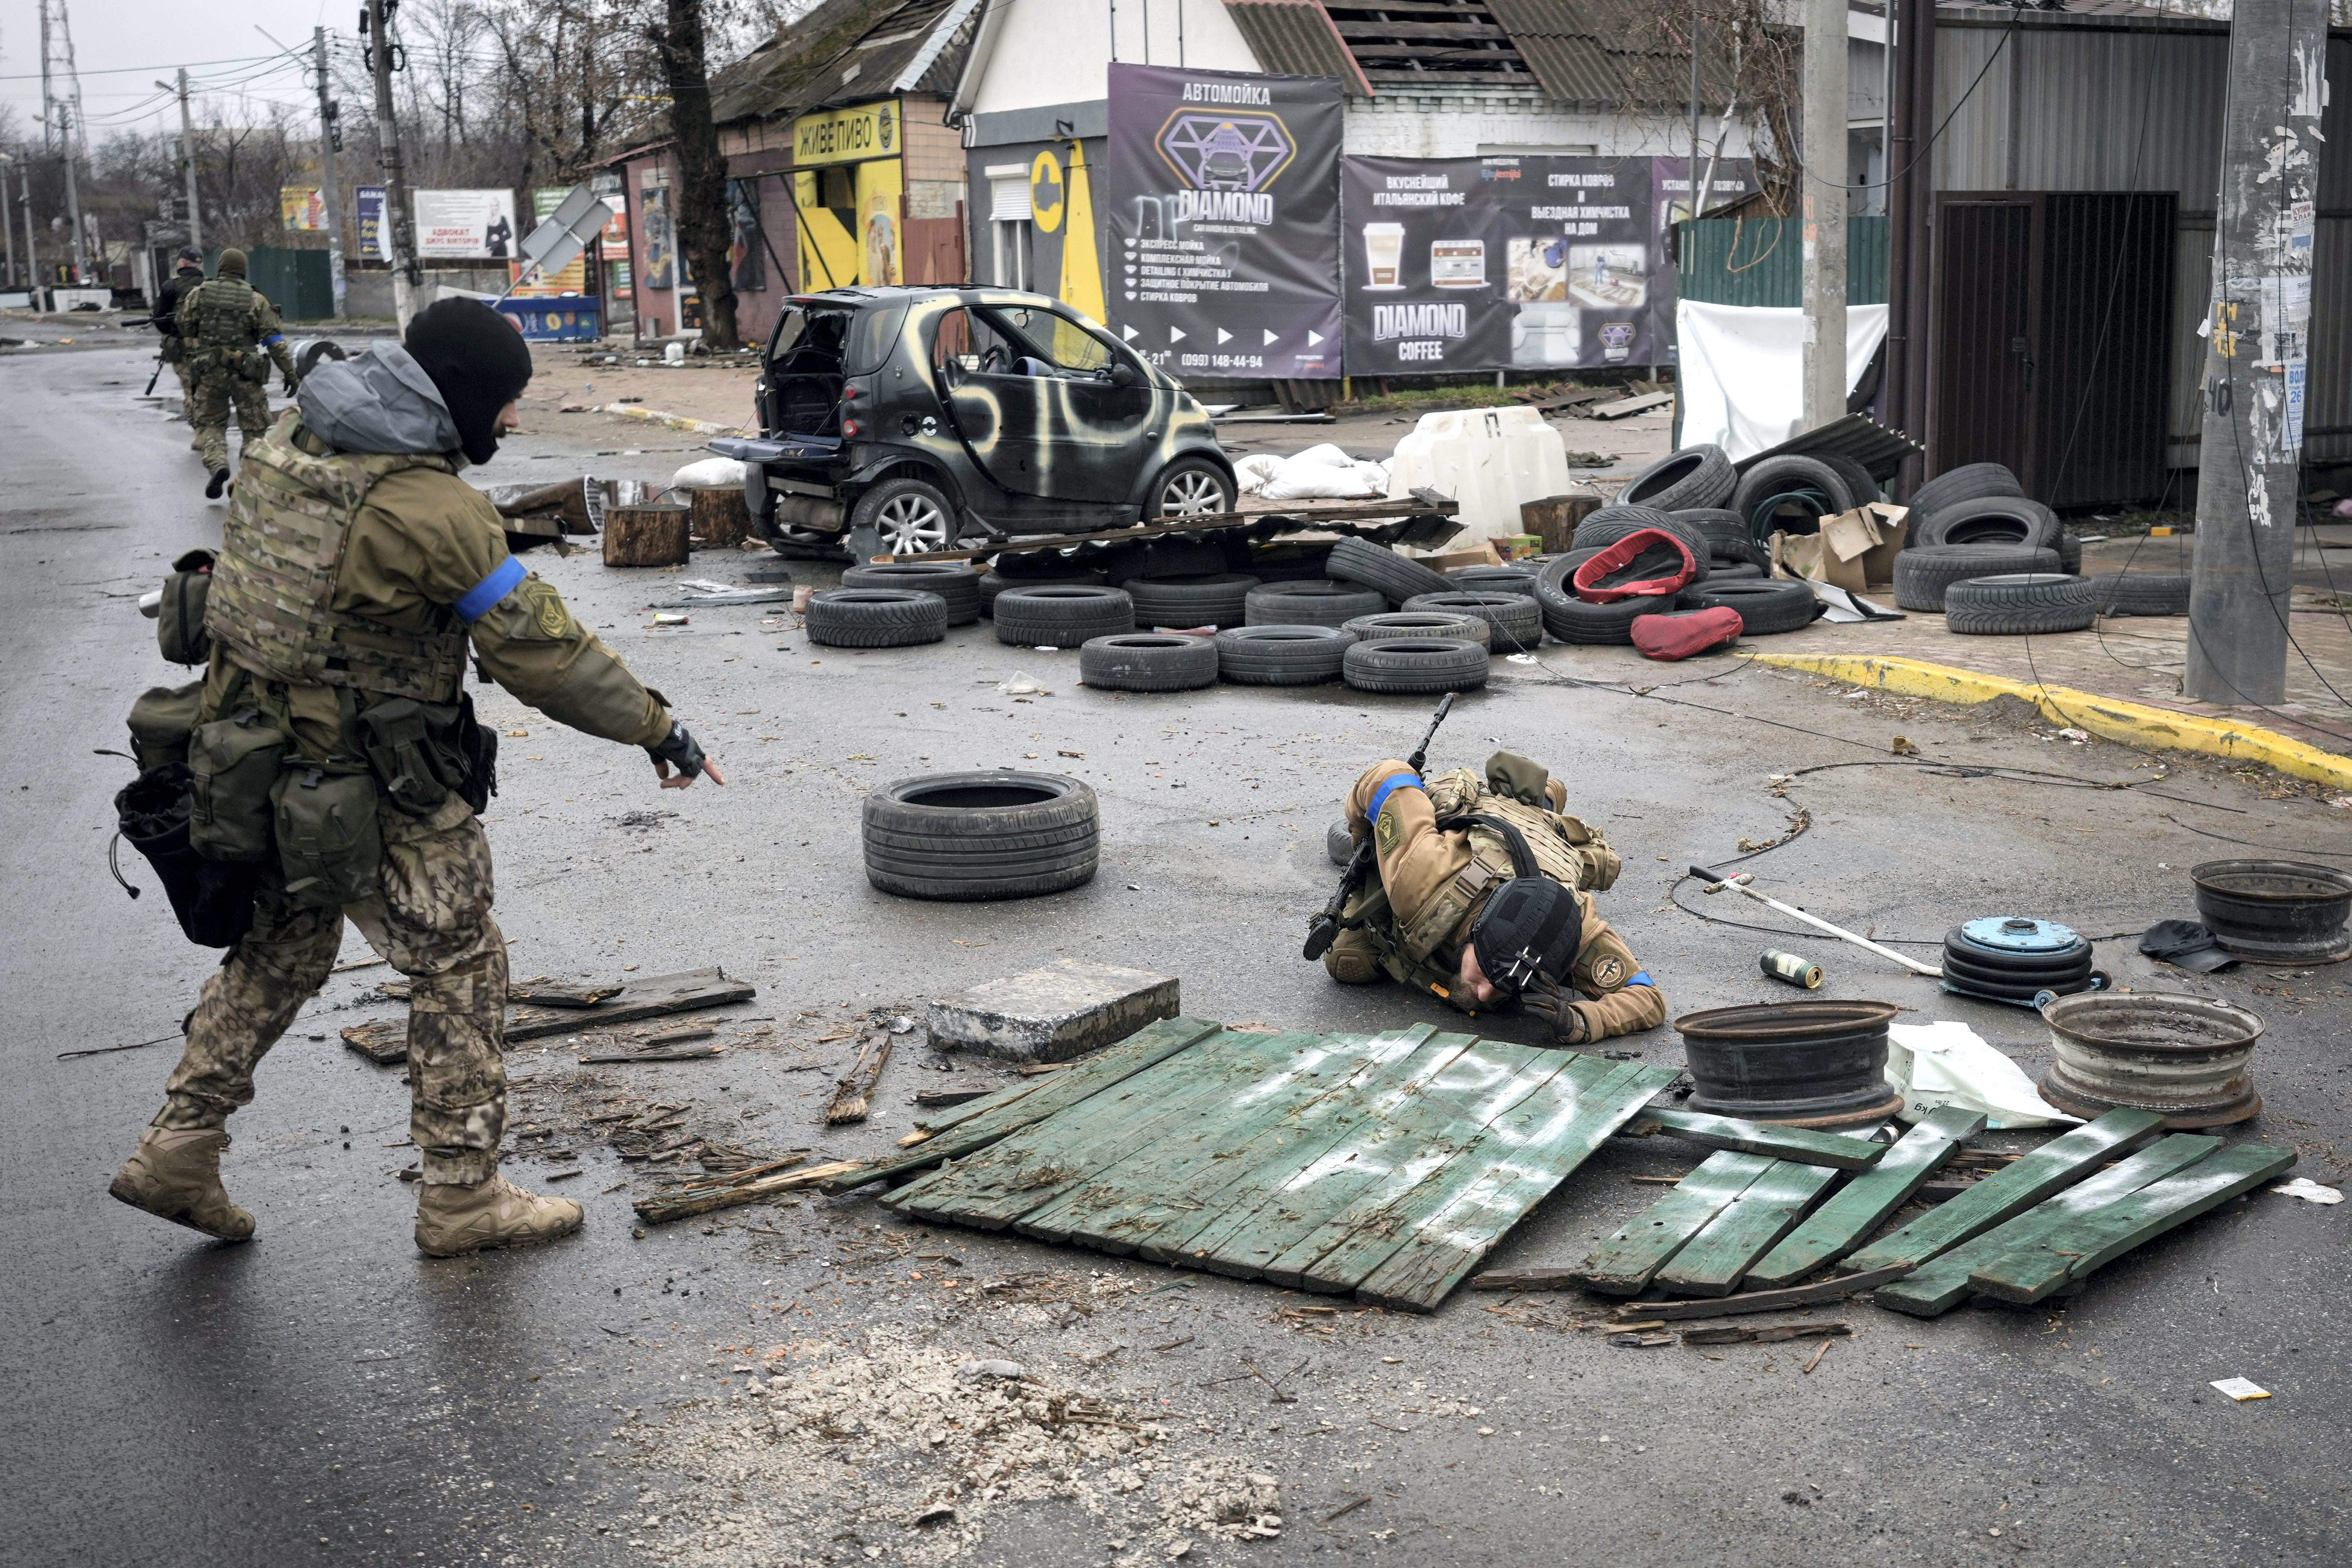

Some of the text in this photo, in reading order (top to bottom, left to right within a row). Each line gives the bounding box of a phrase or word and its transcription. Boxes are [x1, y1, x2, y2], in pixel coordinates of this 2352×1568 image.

[1182, 81, 1271, 106] АВТОМОЙКА
[800, 122, 834, 156] ЖИВЕ
[837, 116, 871, 151] ПИВО
[1386, 174, 1448, 189] ВКУСНЕЙШИЙ
[1548, 174, 1581, 187] СТИРКА
[1373, 191, 1465, 206] ИТАЛЬЯНСКИЙ КОФЕ
[1578, 191, 1585, 203] И
[1178, 189, 1273, 226] DIAMOND
[1531, 206, 1631, 218] ВЫЕЗДНАЯ ХИМЧИСТКА
[2292, 203, 2311, 216] КУПИМ
[1565, 222, 1598, 235] НА ДОМ
[1140, 239, 1204, 251] ЭКСПРЕСС МОЙКА
[1141, 253, 1222, 265] КОМПЛЕКСНАЯ МОЙКА
[1141, 265, 1176, 276] DETAILING
[1182, 266, 1227, 277] ХИМЧИСТКА
[1140, 278, 1179, 289] ЗАЩИТНОЕ
[1221, 282, 1269, 291] АВТОМОБИЛЯ
[1140, 292, 1198, 303] СТИРКА КОВРОВ
[1373, 303, 1467, 342] DIAMOND
[1398, 341, 1444, 361] COFFEE
[1181, 354, 1208, 366] (099)
[1212, 355, 1263, 368] 148-44-94
[2290, 391, 2302, 403] 26
[1914, 1103, 1928, 1114] kg
